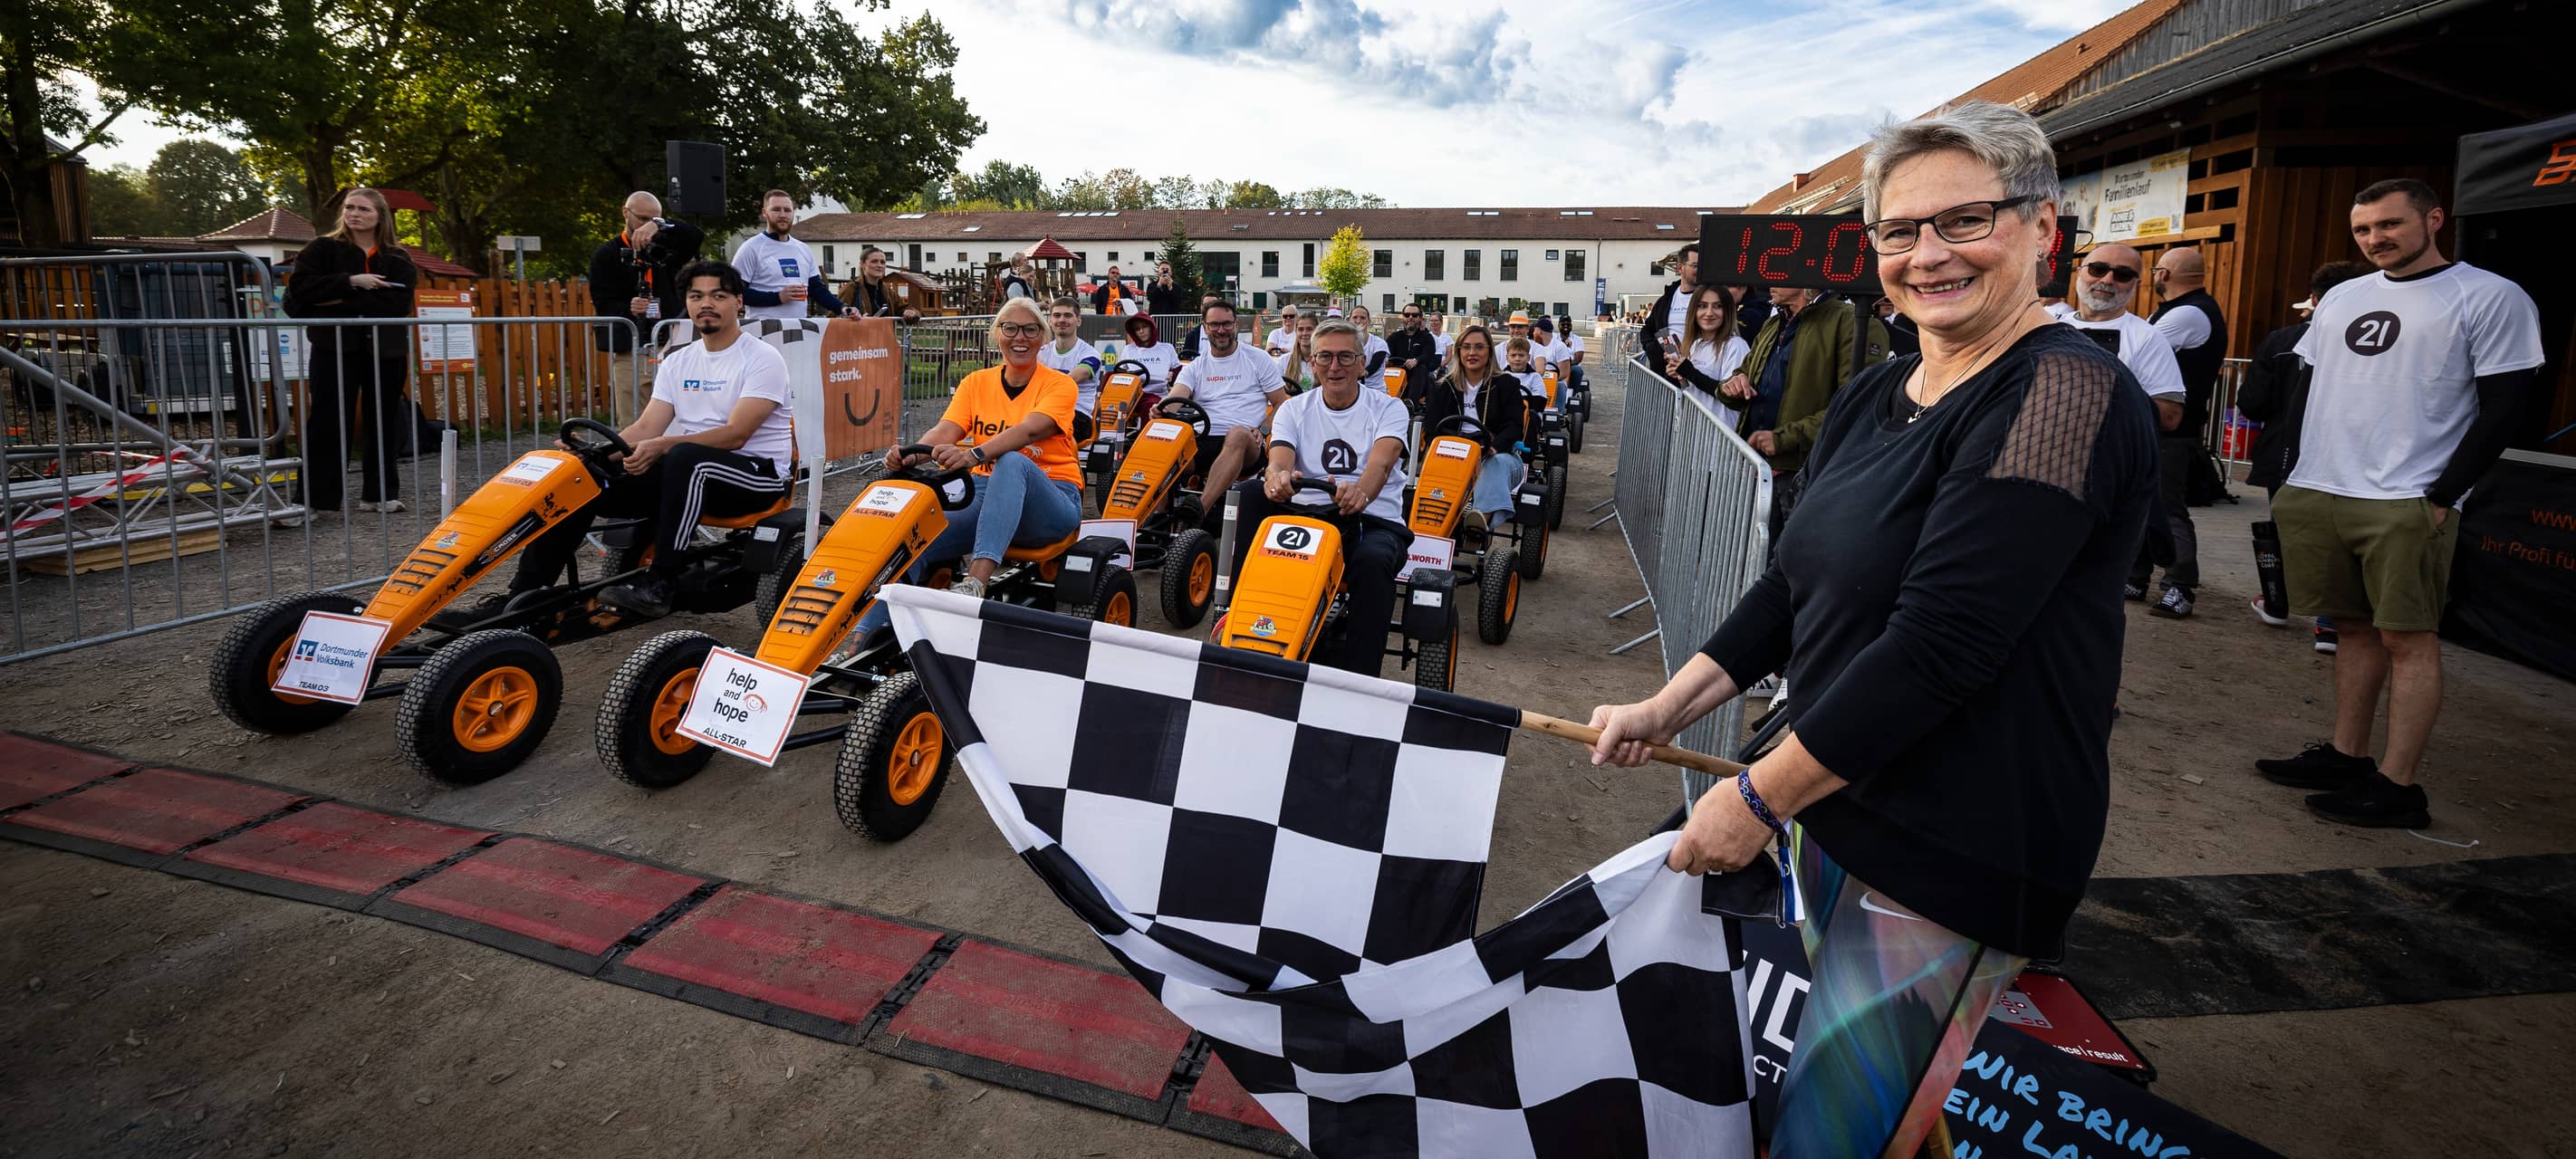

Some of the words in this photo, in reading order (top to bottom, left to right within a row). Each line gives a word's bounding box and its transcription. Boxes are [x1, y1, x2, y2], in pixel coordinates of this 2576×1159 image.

[2104, 179, 2151, 203] Familienlauf
[2355, 320, 2391, 347] 21
[829, 346, 889, 364] gemeinsam
[829, 368, 861, 382] stark.
[973, 415, 1014, 436] hel
[1328, 445, 1350, 469] 21
[852, 508, 896, 519] ALL-STAR
[1282, 531, 1305, 547] 21
[1267, 549, 1296, 559] TEAM
[2481, 536, 2505, 553] Ihr
[2508, 541, 2552, 565] Profi
[320, 643, 369, 659] Dortmunder
[316, 654, 355, 669] Volksbank
[298, 681, 318, 691] TEAM
[726, 667, 757, 693] help
[723, 688, 742, 701] and
[713, 697, 748, 723] hope
[703, 727, 747, 748] ALL-STAR
